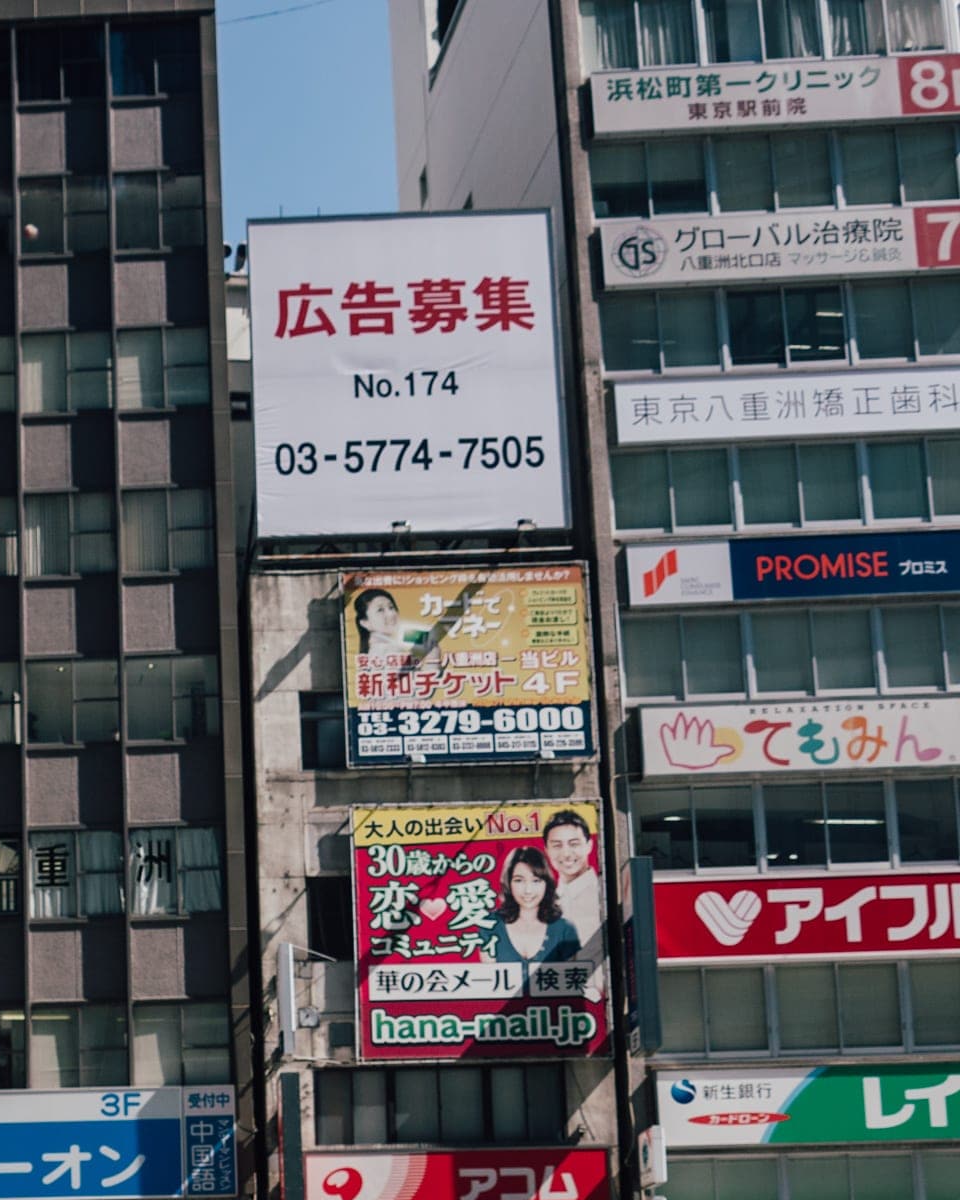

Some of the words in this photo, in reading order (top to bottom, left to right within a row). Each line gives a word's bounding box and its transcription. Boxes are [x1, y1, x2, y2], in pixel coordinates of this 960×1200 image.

[606, 65, 882, 102] 浜松町第一クリニック
[686, 97, 808, 120] 東京駅前院
[674, 217, 904, 252] グローバル治療院
[680, 252, 782, 271] 八重洲北口店
[274, 276, 535, 339] 広告募集
[353, 371, 459, 398] No.174
[631, 383, 960, 426] 東京八重洲矯正歯科
[275, 436, 545, 475] 03-5774-7505
[755, 551, 888, 581] PROMISE
[899, 559, 949, 575] プロミス
[420, 590, 502, 616] カードで
[521, 650, 580, 669] 当ビル
[357, 670, 517, 698] 新和チケット
[521, 671, 580, 695] 4F
[358, 711, 394, 723] TEL
[398, 706, 585, 734] 3279-6000
[749, 703, 865, 715] RELAXATION
[878, 702, 930, 711] SPACE
[744, 715, 942, 766] てもみん
[364, 816, 484, 838] 大人の出会い
[367, 844, 496, 877] 30歳からの
[370, 933, 499, 959] コミュニティ
[376, 969, 516, 994] 華の会メール
[535, 966, 590, 992] 検索
[373, 1007, 595, 1044] hana-mail.jp
[100, 1093, 142, 1117] 3F
[188, 1093, 230, 1108] 受付中
[703, 1082, 774, 1101] 新生銀行
[708, 1113, 771, 1125] カードローン
